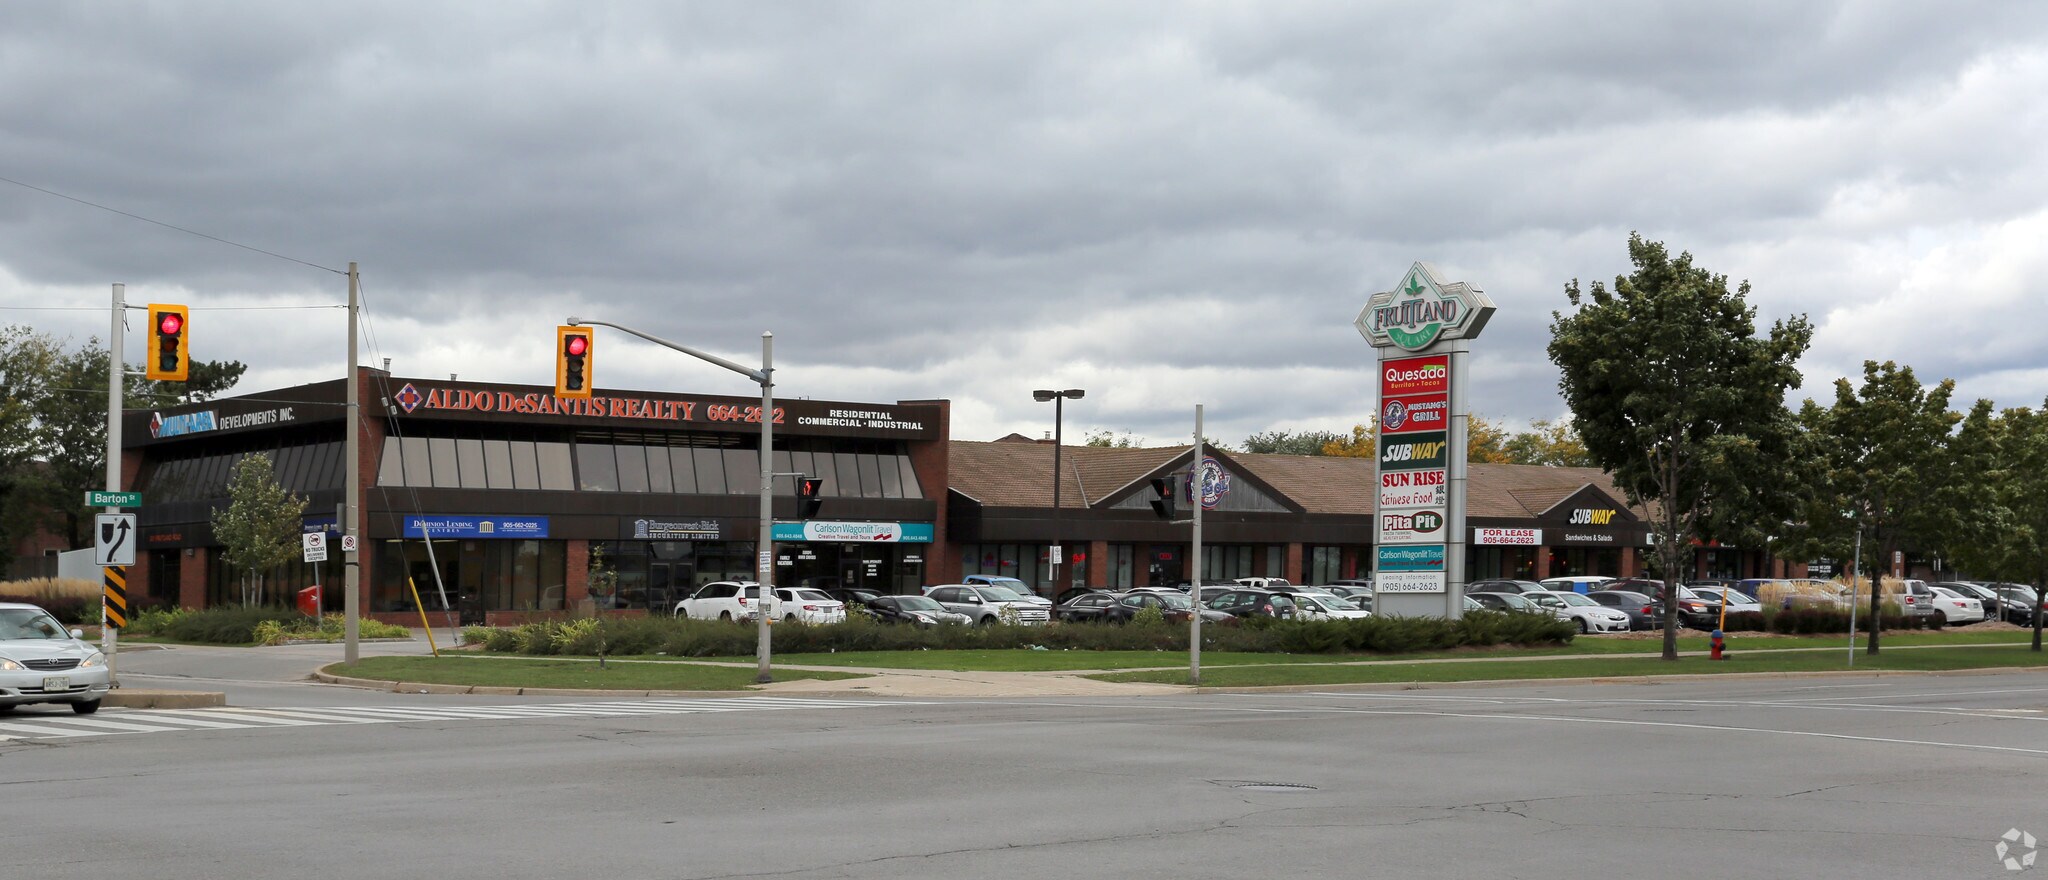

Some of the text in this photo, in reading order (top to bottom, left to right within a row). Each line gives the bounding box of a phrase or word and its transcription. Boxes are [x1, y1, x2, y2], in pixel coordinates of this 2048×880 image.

[1374, 299, 1457, 331] FRUITLAND
[1396, 329, 1431, 346] SQUARE
[1386, 365, 1445, 382] Quesada
[424, 388, 784, 424] ALDO DeSANTIS REALTY 664-262
[1408, 401, 1446, 410] MUSTANG'S
[220, 410, 277, 430] DEVELOPMENTS
[280, 407, 295, 422] INC.
[830, 410, 892, 420] RESIDENTIAL
[1413, 411, 1440, 422] GRILL
[798, 417, 923, 430] COMMERCIAL INDUSTRIAL
[1382, 440, 1445, 462] SUBWAY
[1382, 471, 1444, 487] SUN RISE
[95, 494, 127, 503] Barton
[1381, 492, 1432, 505] Chinese Food
[1383, 515, 1436, 530] Pita Pit
[1570, 509, 1616, 524] SUBWAY
[814, 524, 892, 535] Carlson Wagonlit Travel
[1380, 550, 1402, 558] Carlson
[1402, 550, 1427, 560] Wagonlit
[1382, 583, 1401, 591] (905)
